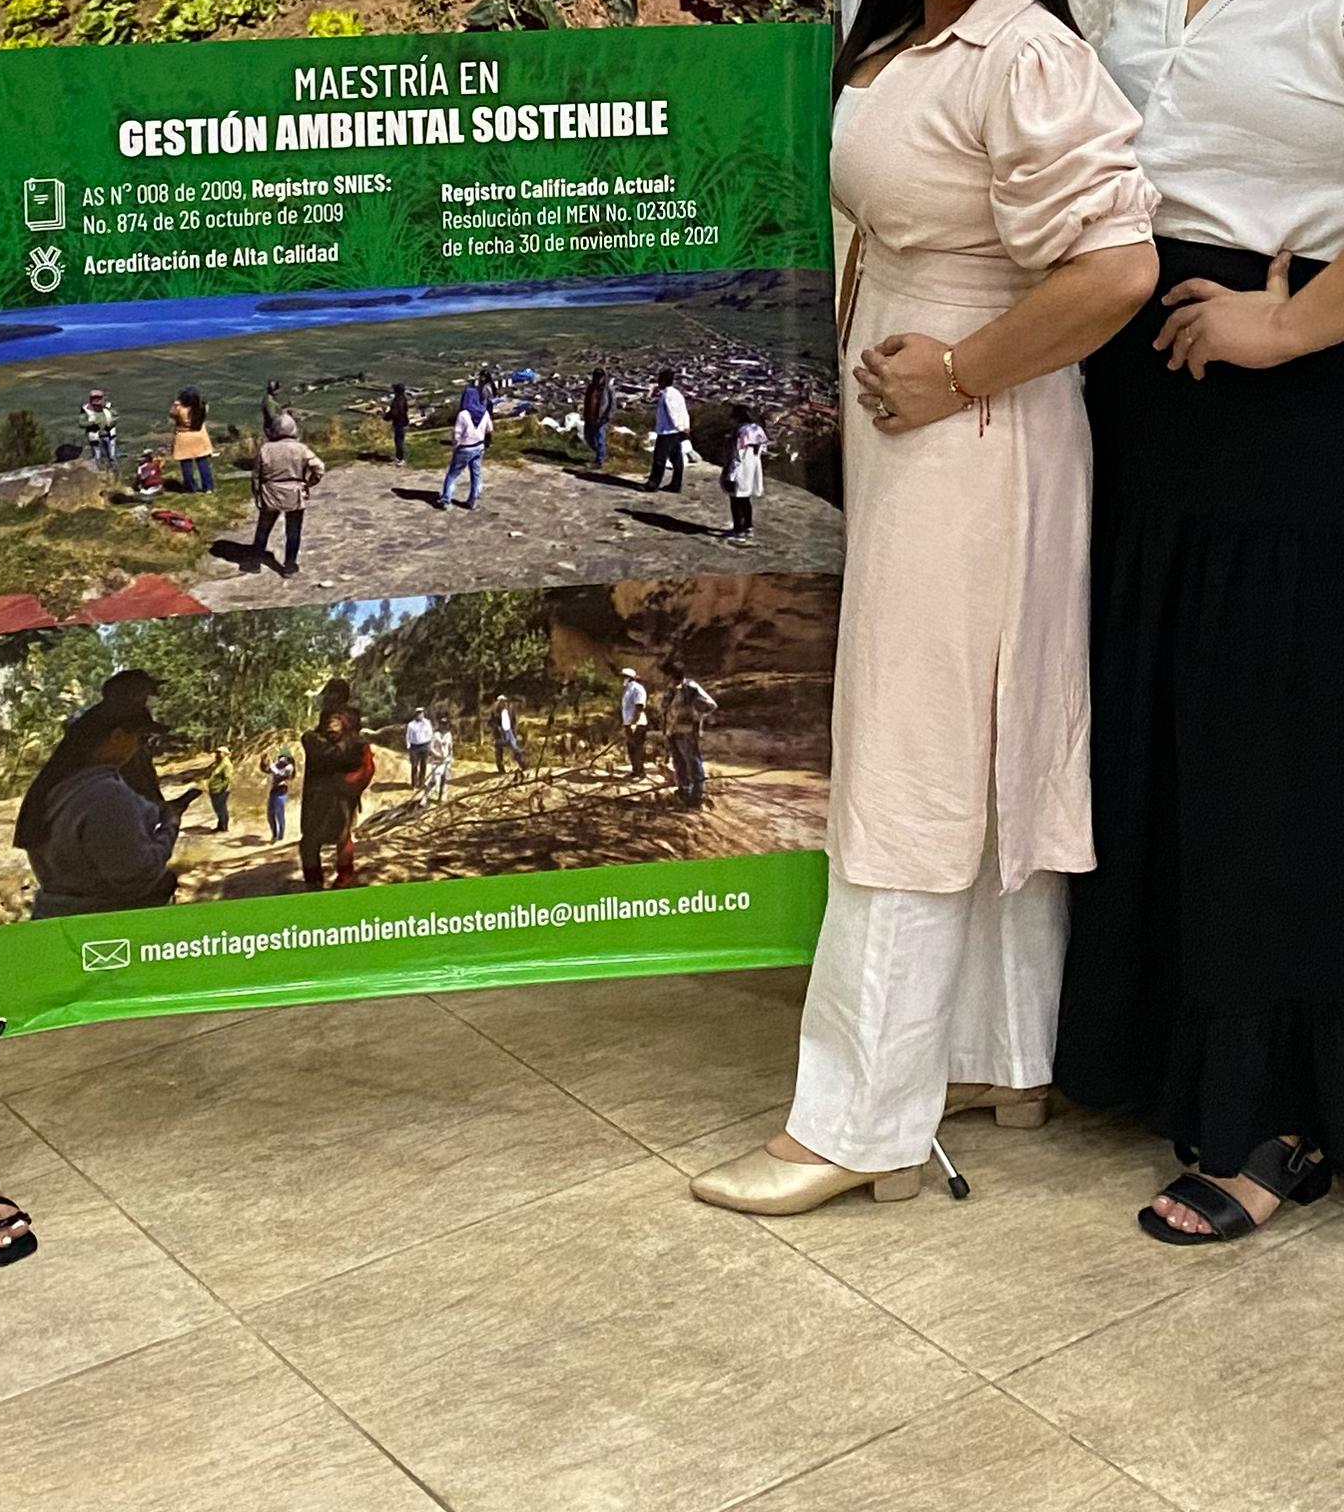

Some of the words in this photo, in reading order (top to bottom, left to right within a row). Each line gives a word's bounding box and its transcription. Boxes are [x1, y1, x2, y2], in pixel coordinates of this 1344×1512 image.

[294, 54, 449, 102] MAESTRÍA
[460, 60, 500, 95] EN
[118, 110, 268, 158] GESTIÓN
[274, 109, 465, 152] AMBIENTAL
[471, 99, 669, 143] SOSTENIBLE
[82, 187, 105, 207] AS
[137, 184, 169, 204] 008
[175, 182, 196, 203] de
[200, 179, 248, 202] 2009,
[251, 175, 330, 203] Registro
[333, 173, 393, 195] SNIES:
[440, 180, 517, 208] Registro
[520, 177, 610, 201] Calificado
[613, 174, 676, 196] Actual:
[83, 214, 112, 235] No.
[117, 212, 149, 234] 874
[153, 210, 175, 232] de
[179, 209, 200, 231] 26
[205, 205, 273, 229] octubre
[277, 206, 299, 226] de
[303, 203, 344, 224] 2009
[442, 207, 532, 230] Resolución
[537, 205, 562, 227] del
[567, 204, 601, 224] MEN
[606, 202, 632, 223] No.
[636, 199, 698, 221] 023036
[442, 236, 463, 258] de
[467, 234, 514, 256] fecha
[519, 233, 540, 254] 30
[544, 231, 565, 252] de
[570, 228, 656, 251] noviembre
[660, 226, 680, 247] de
[684, 224, 719, 246] 2021
[83, 251, 200, 276] Acreditación
[205, 249, 229, 270] de
[233, 245, 268, 268] Alta
[272, 242, 339, 266] Calidad
[140, 888, 751, 963] maestriagestionambientalsostenible@unillanos.edu.co
